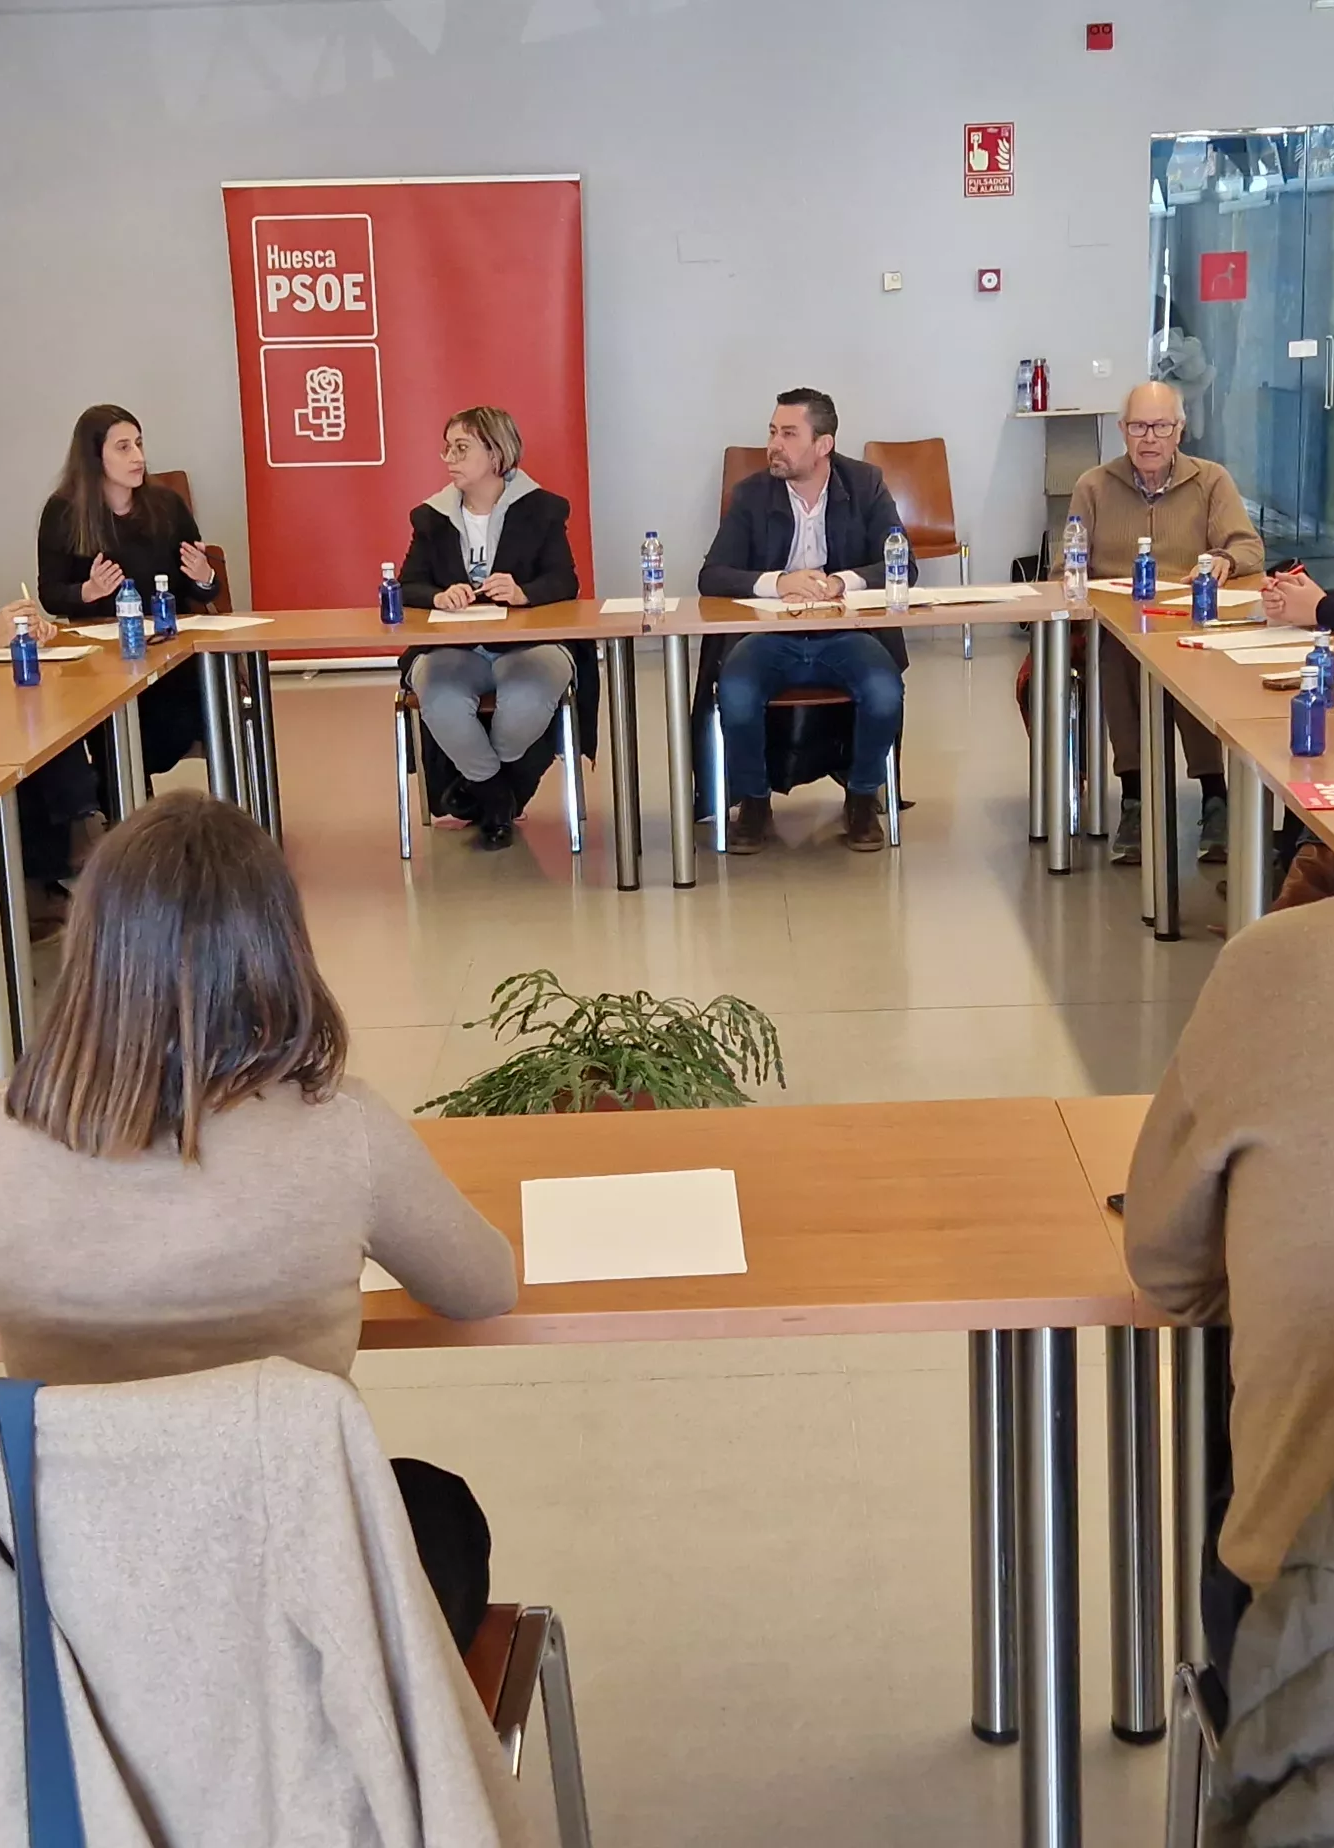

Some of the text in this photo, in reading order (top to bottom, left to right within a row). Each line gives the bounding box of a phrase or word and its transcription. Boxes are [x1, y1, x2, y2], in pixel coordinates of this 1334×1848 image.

[968, 178, 1010, 186] PULSADOR
[980, 185, 1010, 193] ALARMA
[266, 244, 336, 269] Huesca
[266, 273, 367, 313] PSOE
